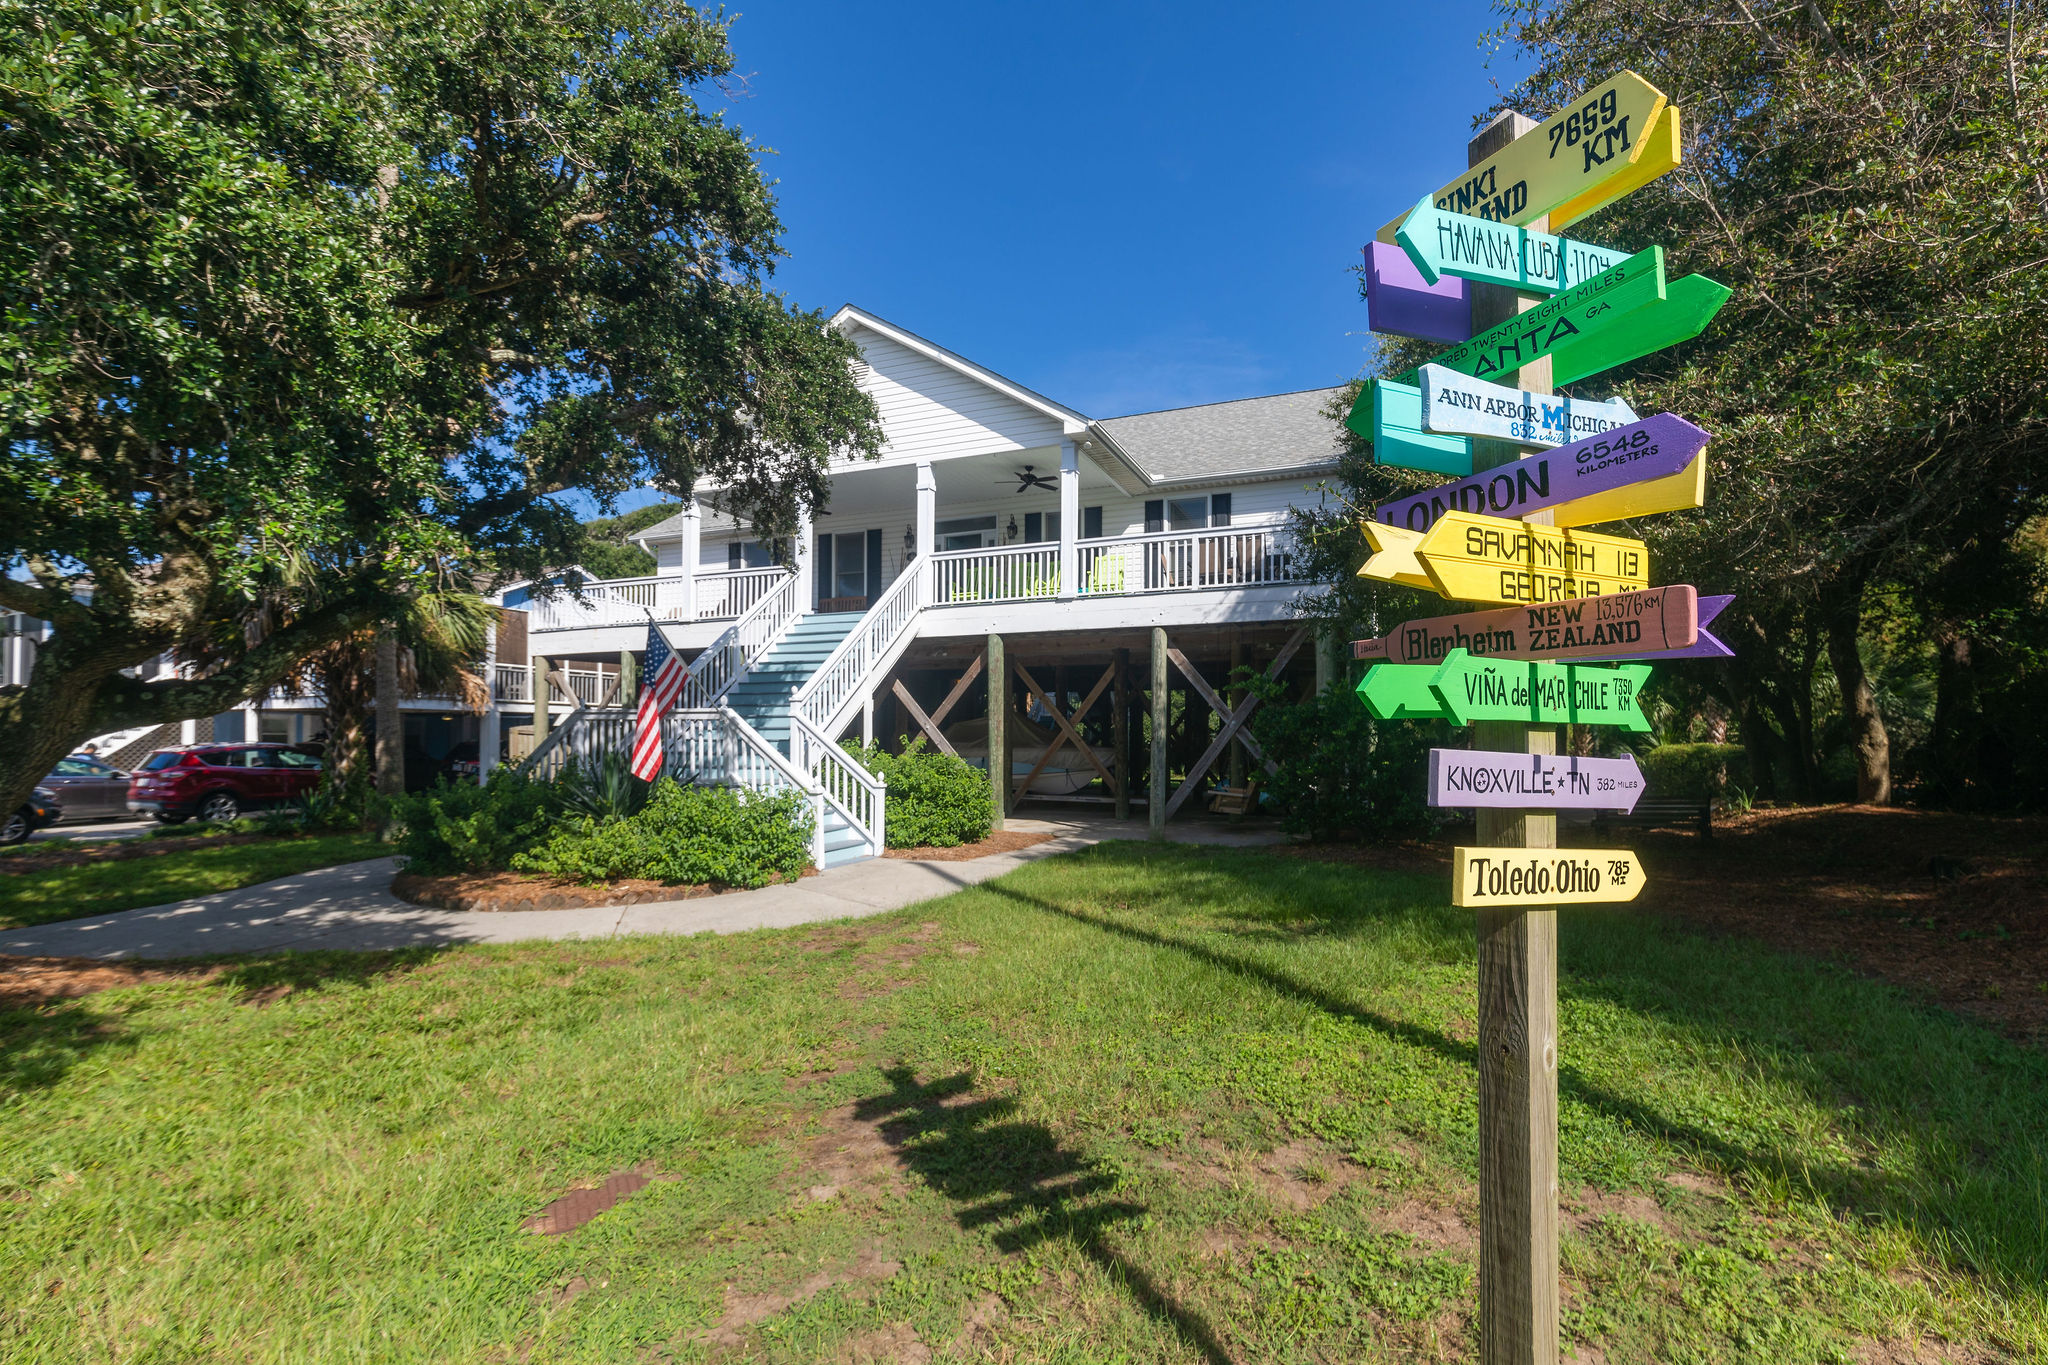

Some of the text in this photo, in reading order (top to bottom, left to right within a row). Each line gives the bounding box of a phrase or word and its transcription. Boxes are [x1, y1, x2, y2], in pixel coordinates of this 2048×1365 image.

[1549, 89, 1616, 159] 7659
[1582, 115, 1631, 174] KM
[1436, 165, 1497, 214] SINKI
[1437, 218, 1517, 272] HAVANA
[1523, 238, 1569, 283] CUBA
[1471, 318, 1524, 352] TWENTY
[1528, 295, 1570, 325] EIGHT
[1577, 267, 1625, 301] MILES
[1585, 301, 1612, 319] GA
[1473, 316, 1580, 378] ANTA
[1438, 388, 1482, 411] ANN
[1484, 397, 1541, 423] ARBOR
[1510, 422, 1537, 439] 832
[1576, 430, 1650, 463] 6548
[1577, 445, 1658, 477] KILOMETERS
[1466, 527, 1638, 576] SAVANNAH 113
[1500, 571, 1600, 602] GEORGIA
[1527, 593, 1661, 629] NEW 13,576 KM
[1406, 624, 1516, 661] Blenheim
[1529, 620, 1641, 651] ZEALAND
[1464, 667, 1608, 710] VIÑA del MAR CHILE
[1612, 678, 1633, 696] 7350
[1618, 696, 1631, 711] KM
[1447, 765, 1554, 793] KNOXVILLE
[1566, 771, 1590, 795] TN
[1597, 778, 1616, 791] 382
[1470, 858, 1600, 896] Toledo Ohio
[1607, 860, 1630, 876] 785
[1611, 876, 1626, 885] MI
